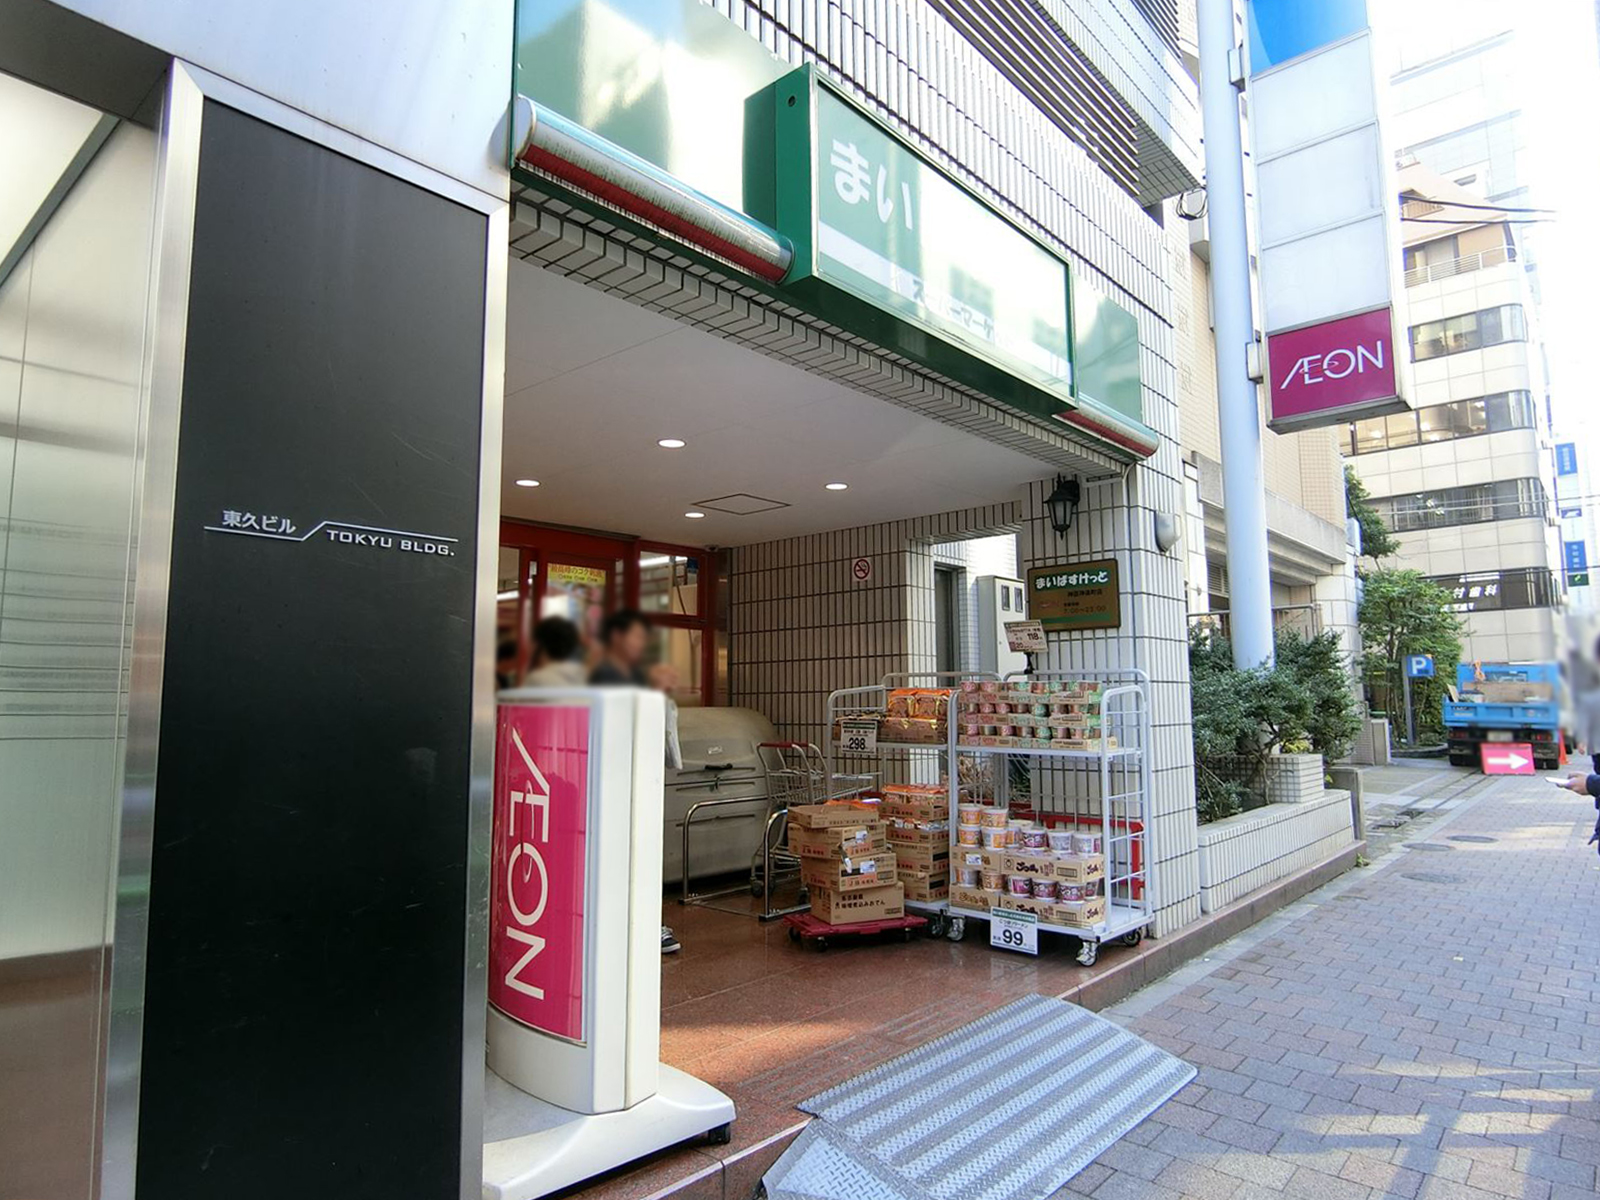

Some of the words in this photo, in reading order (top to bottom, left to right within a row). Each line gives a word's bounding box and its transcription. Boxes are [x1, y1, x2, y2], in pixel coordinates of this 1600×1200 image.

[222, 509, 297, 535] 東久ビル
[326, 529, 393, 549] TOKYU
[400, 539, 455, 557] BLDG.
[1036, 571, 1108, 588] まいばすけっと
[1411, 658, 1427, 675] P
[849, 737, 866, 750] 298
[1002, 929, 1024, 947] 99
